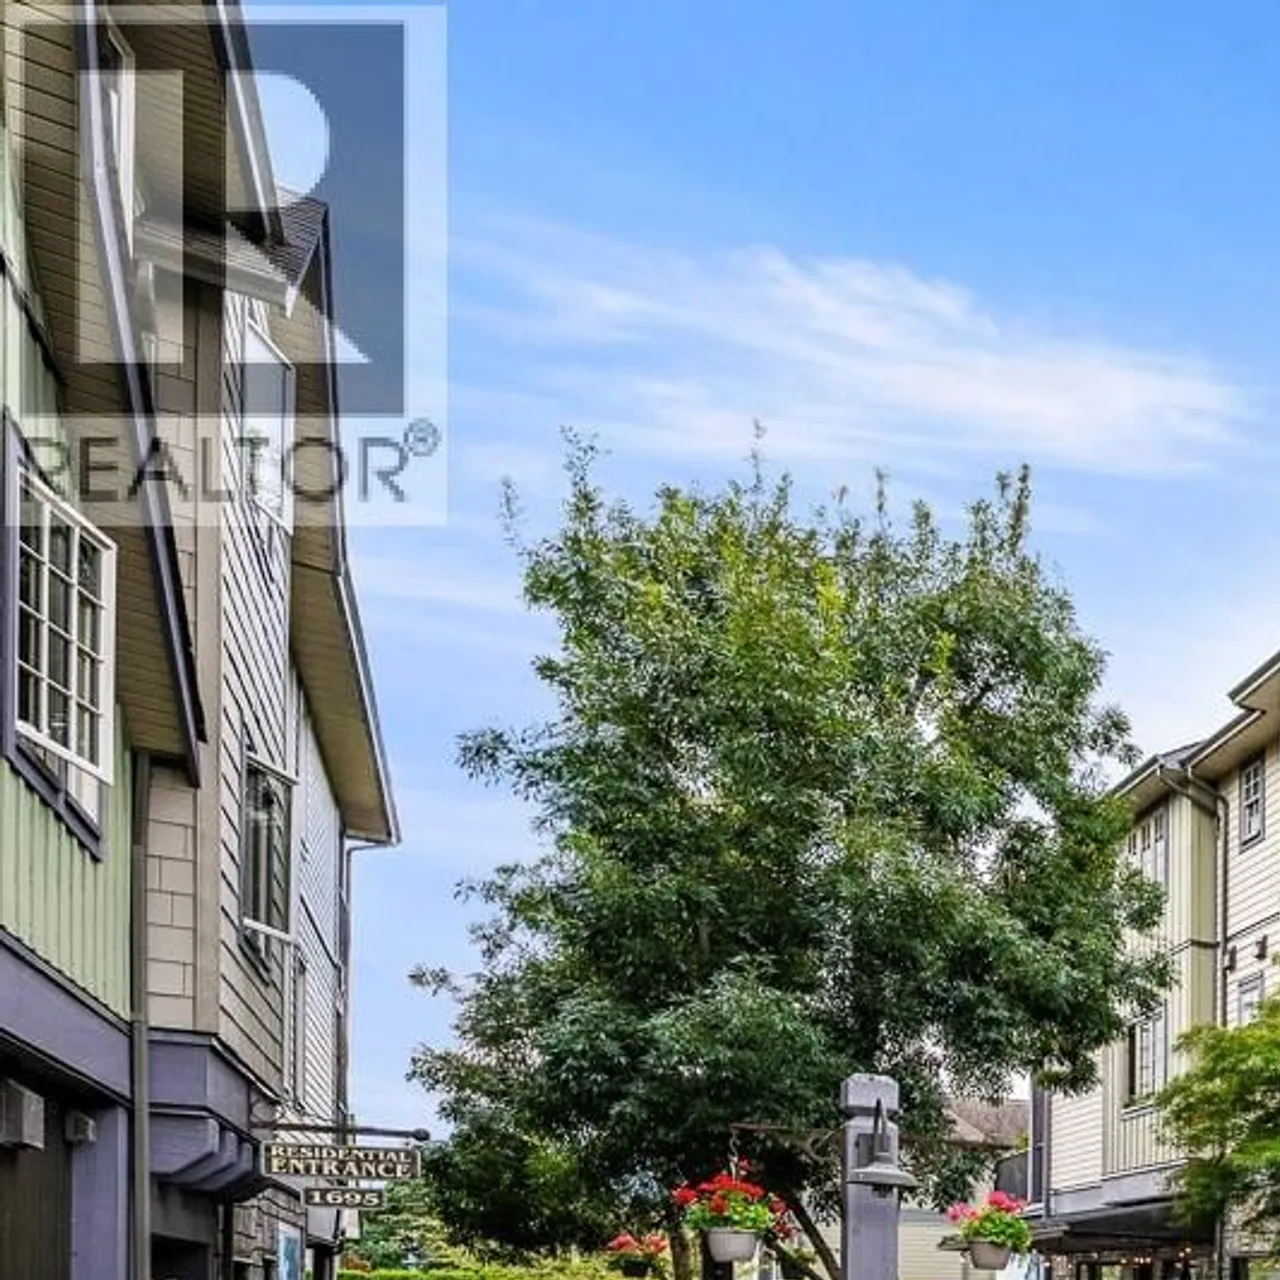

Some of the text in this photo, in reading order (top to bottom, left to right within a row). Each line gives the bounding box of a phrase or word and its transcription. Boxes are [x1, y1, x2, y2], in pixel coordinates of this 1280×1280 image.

[271, 1144, 412, 1163] RESIDENTIAL
[271, 1158, 412, 1178] ENTRANCE
[309, 1190, 380, 1206] 1695
